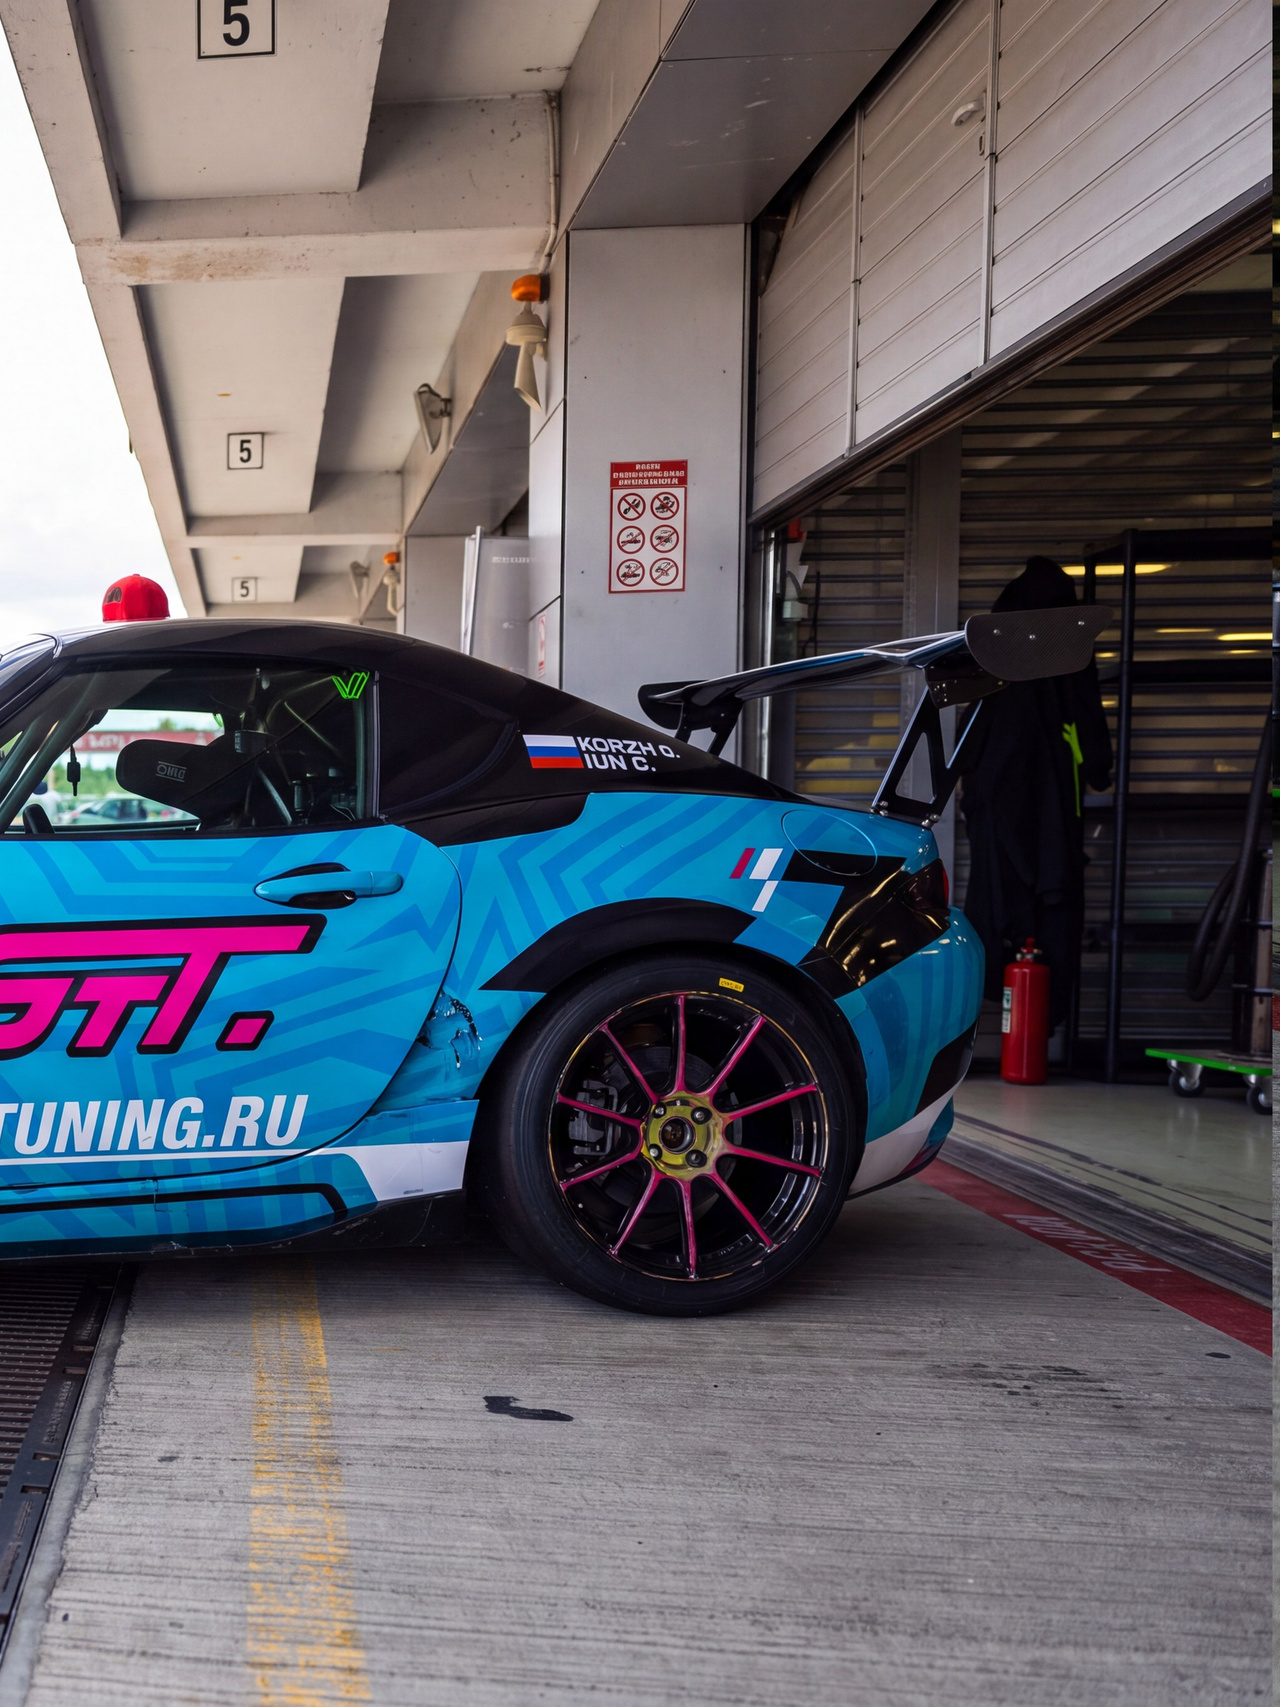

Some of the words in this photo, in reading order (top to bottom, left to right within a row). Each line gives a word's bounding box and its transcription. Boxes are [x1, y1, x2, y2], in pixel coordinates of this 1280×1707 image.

[223, 0, 250, 46] 5
[240, 439, 251, 463] 5
[240, 580, 249, 598] 5
[577, 736, 657, 756] KORZH
[584, 753, 628, 770] IUN
